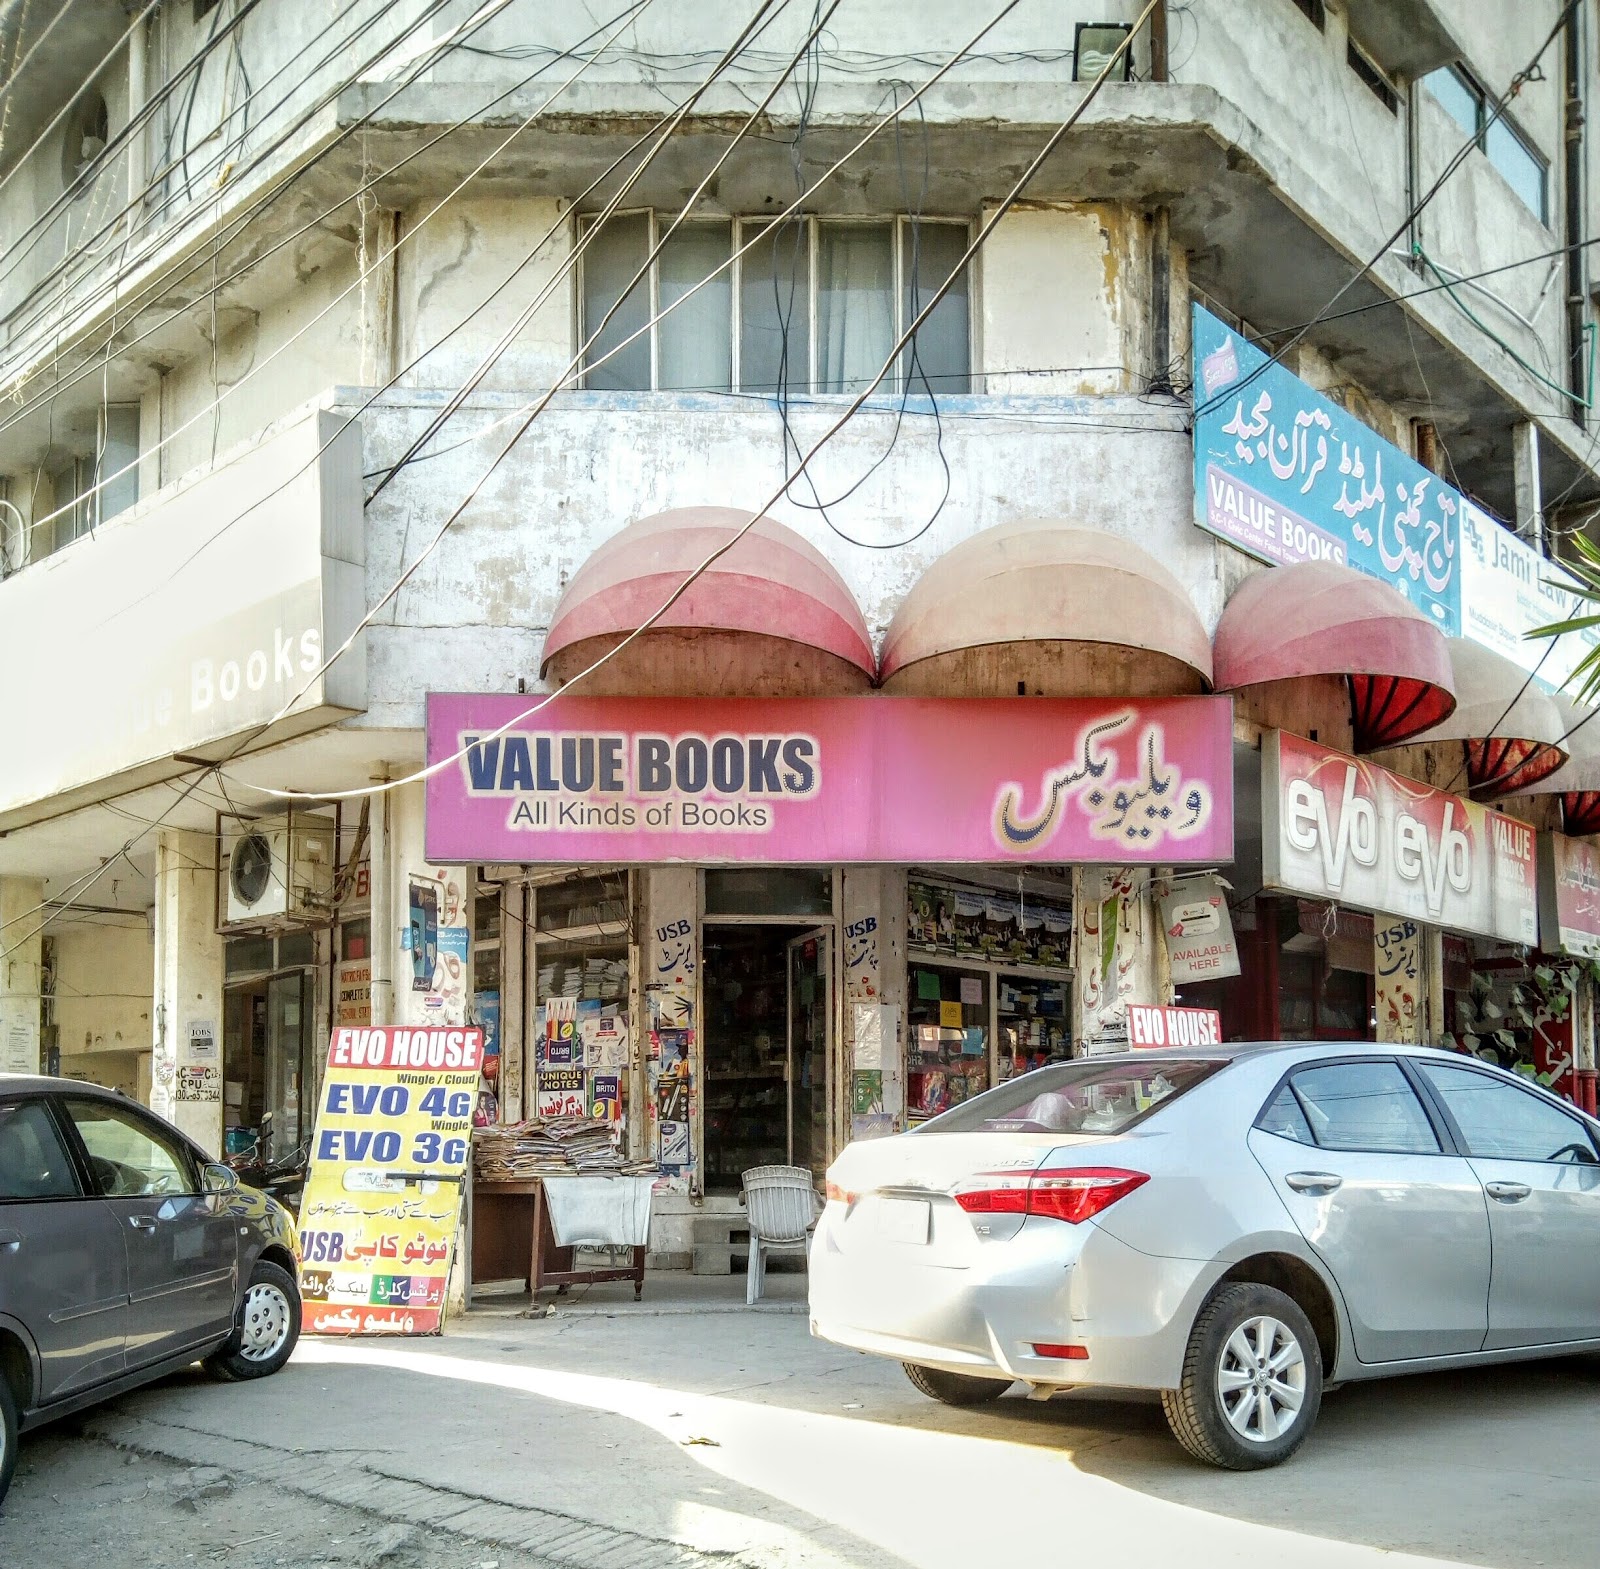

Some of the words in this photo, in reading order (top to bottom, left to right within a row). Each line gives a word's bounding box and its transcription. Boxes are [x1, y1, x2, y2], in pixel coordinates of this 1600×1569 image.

[1210, 473, 1276, 538] VALUE
[1281, 515, 1344, 564] BOOKS
[1492, 530, 1531, 585] Jami
[1537, 561, 1567, 609] Law
[191, 628, 321, 713] Books
[465, 737, 623, 792] VALUE
[638, 738, 814, 795] BOOKS
[513, 801, 547, 825] All
[559, 802, 636, 826] Kinds
[646, 803, 673, 826] of
[682, 803, 767, 826] Books
[1491, 816, 1532, 861] VALUE
[656, 918, 692, 943] USB
[845, 916, 877, 939] USB
[1374, 921, 1418, 949] USB
[1173, 943, 1233, 962] AVAILABLE
[1189, 957, 1221, 971] HERE
[1132, 1009, 1165, 1045] EVO
[1167, 1011, 1219, 1046] HOUSE
[334, 1029, 387, 1065] EVO
[390, 1030, 478, 1067] HOUSE
[181, 1080, 202, 1089] CPU
[397, 1073, 435, 1085] Wingle
[445, 1074, 476, 1085] Cloud
[541, 1071, 582, 1081] UNIQUE
[544, 1081, 579, 1090] NOTES
[595, 1084, 616, 1093] BRITO
[325, 1084, 409, 1116] EVO
[418, 1087, 471, 1117] 4G
[431, 1120, 468, 1132] Wingle
[317, 1130, 402, 1163] EVO
[411, 1132, 466, 1165] 3G
[300, 1230, 344, 1262] USB
[344, 1235, 400, 1267] کاپی
[401, 1232, 447, 1266] فوٹو
